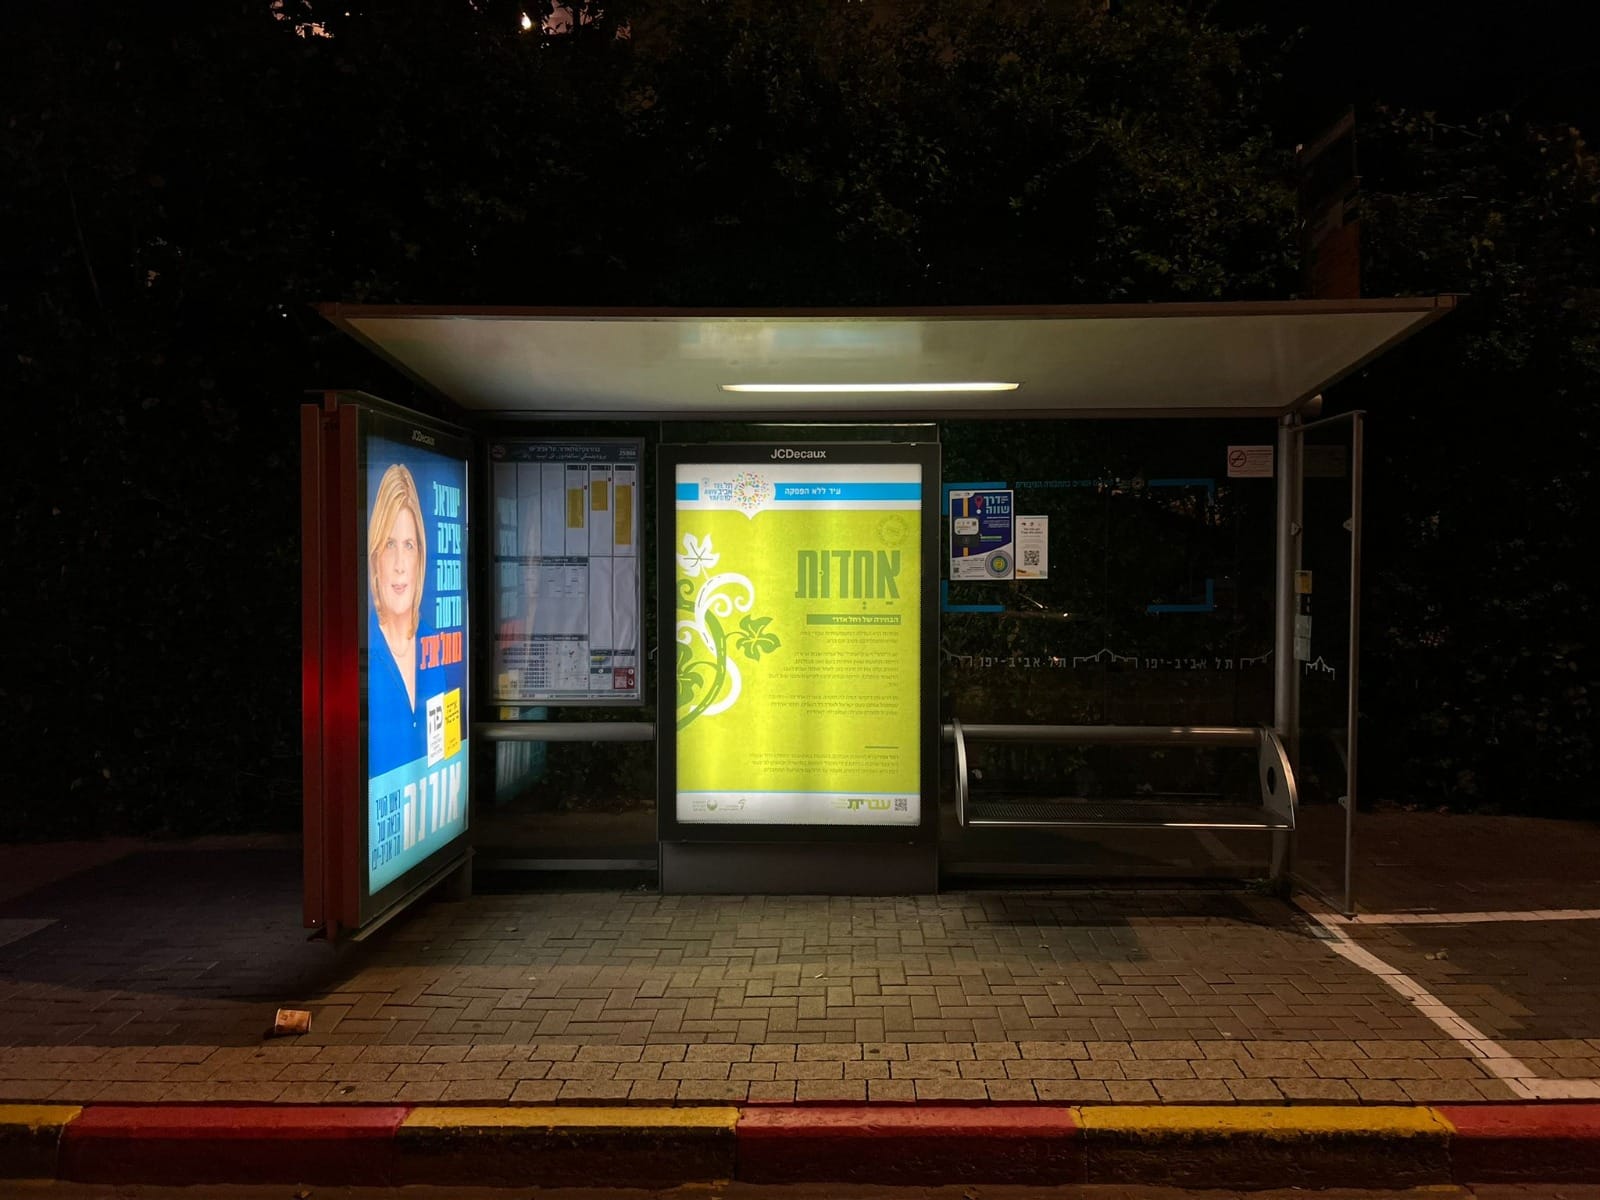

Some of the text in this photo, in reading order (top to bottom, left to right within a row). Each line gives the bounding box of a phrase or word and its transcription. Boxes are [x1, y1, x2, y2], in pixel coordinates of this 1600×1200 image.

[770, 448, 827, 460] JCDecaux
[784, 486, 842, 498] עיר ללא הפסקה
[433, 481, 460, 518] ישראל
[984, 496, 1001, 507] דרך
[986, 505, 1010, 515] שווה
[437, 521, 461, 555] צריכה
[436, 558, 462, 592] הנהגה
[435, 595, 462, 629] חדשה
[848, 615, 862, 623] רחל
[862, 615, 873, 623] של
[873, 616, 899, 624] הבחירה
[420, 634, 441, 670] אביב
[440, 630, 463, 666] מתל
[979, 655, 1067, 669] תל אביב-יפו
[1144, 656, 1234, 670] תל אביב-יפו
[403, 760, 461, 851] אורנה
[846, 798, 892, 811] עברית
[376, 819, 386, 844] של
